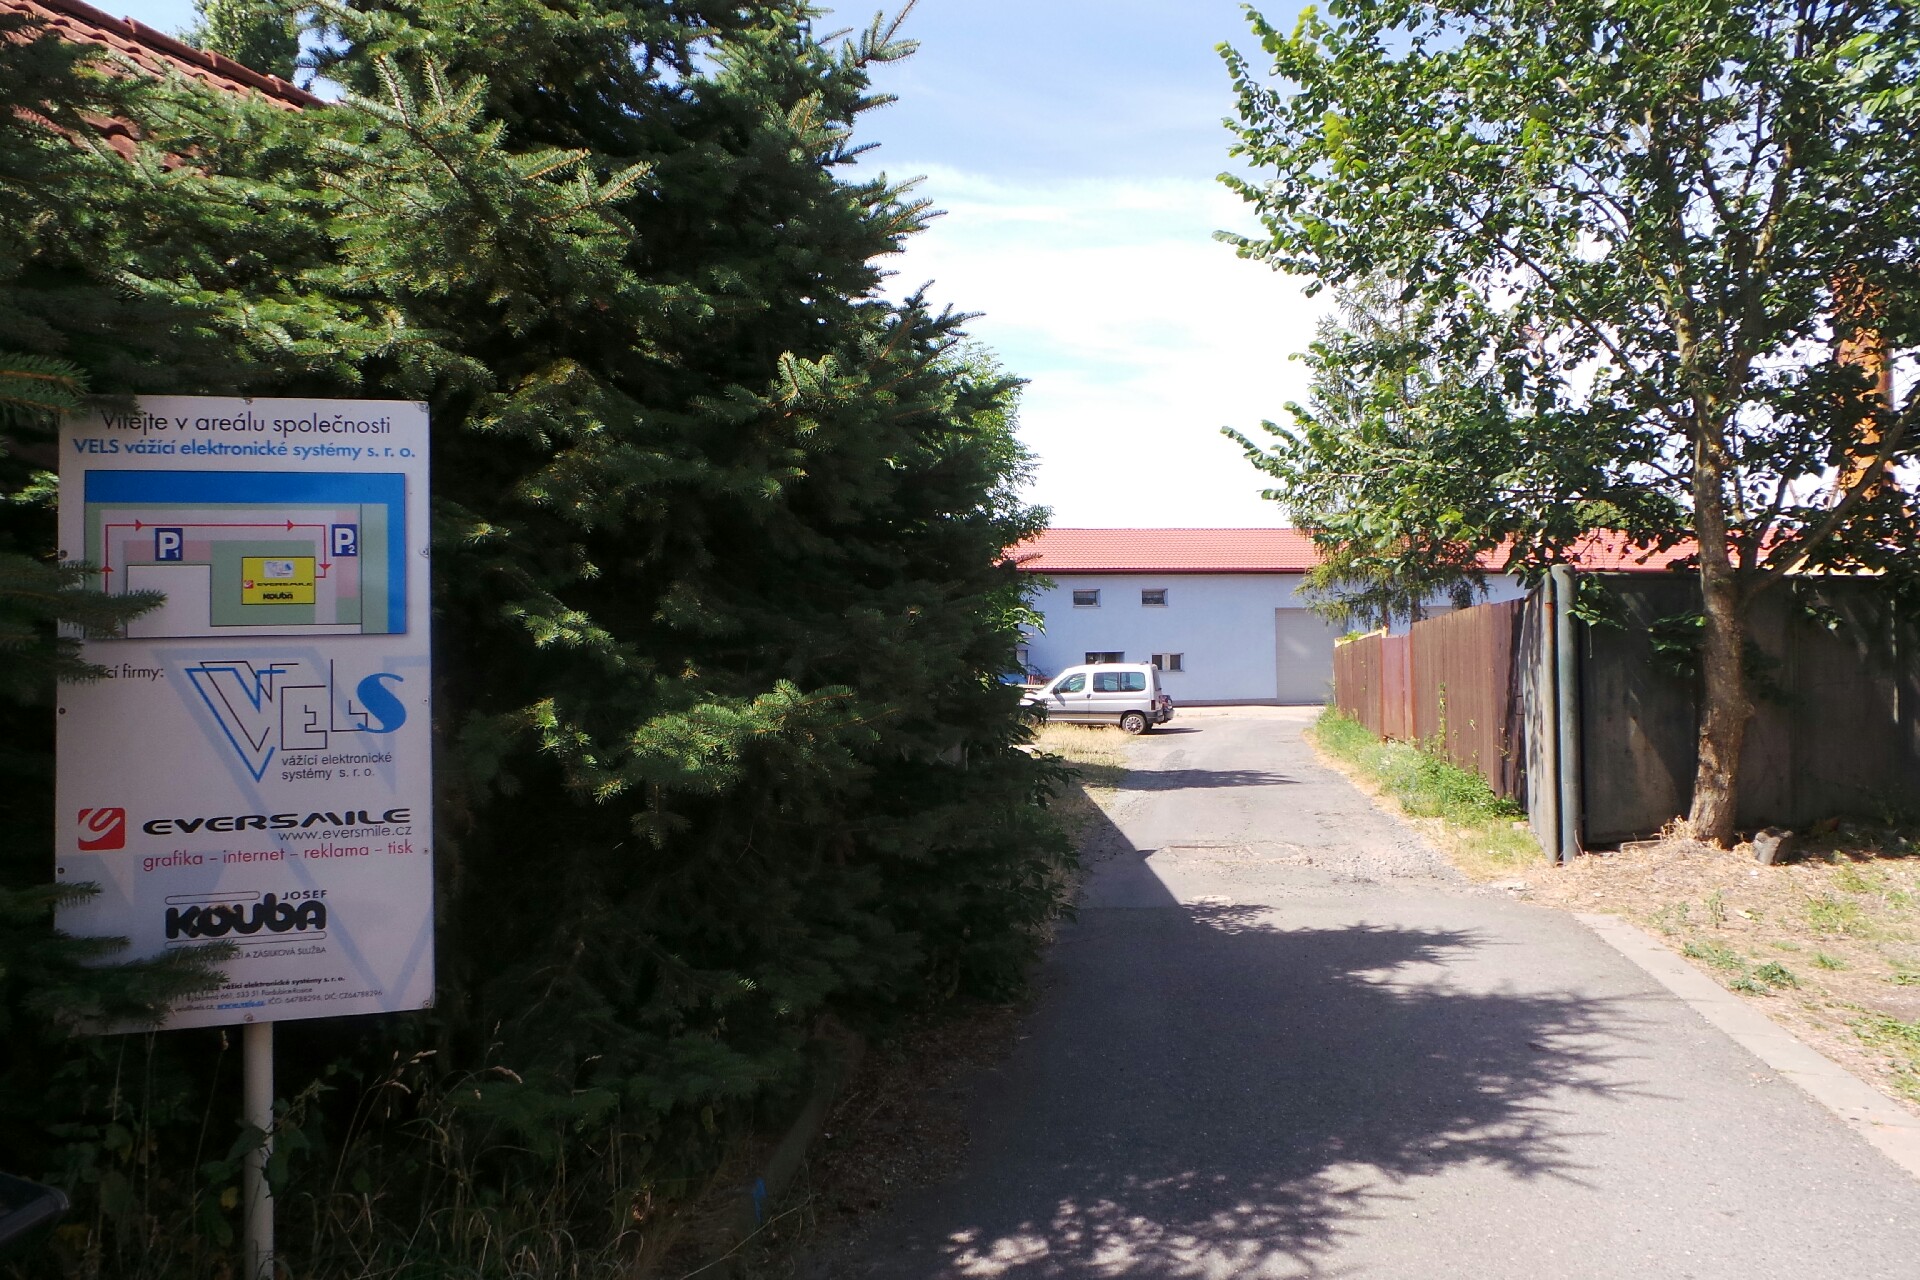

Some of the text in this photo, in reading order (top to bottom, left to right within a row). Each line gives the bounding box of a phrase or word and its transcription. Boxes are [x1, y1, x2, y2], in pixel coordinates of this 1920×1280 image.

[175, 417, 188, 430] v
[195, 411, 265, 431] areálu
[272, 413, 391, 438] společnosti
[73, 438, 416, 460] VELS vážící elektronické systémy s. r. o.
[123, 663, 164, 681] firmy:
[184, 659, 408, 783] VELS
[281, 752, 393, 766] vážící elektronické
[281, 768, 375, 782] systémy s. r. o.
[142, 808, 411, 835] EVERSMILE
[278, 824, 412, 841] www.eversmile.cz
[143, 850, 203, 871] grafika
[223, 848, 286, 864] internet
[304, 843, 369, 860] reklama
[388, 839, 413, 855] tisk
[282, 890, 327, 901] JOSEF
[244, 979, 290, 989] elektronické
[291, 977, 322, 987] systémy
